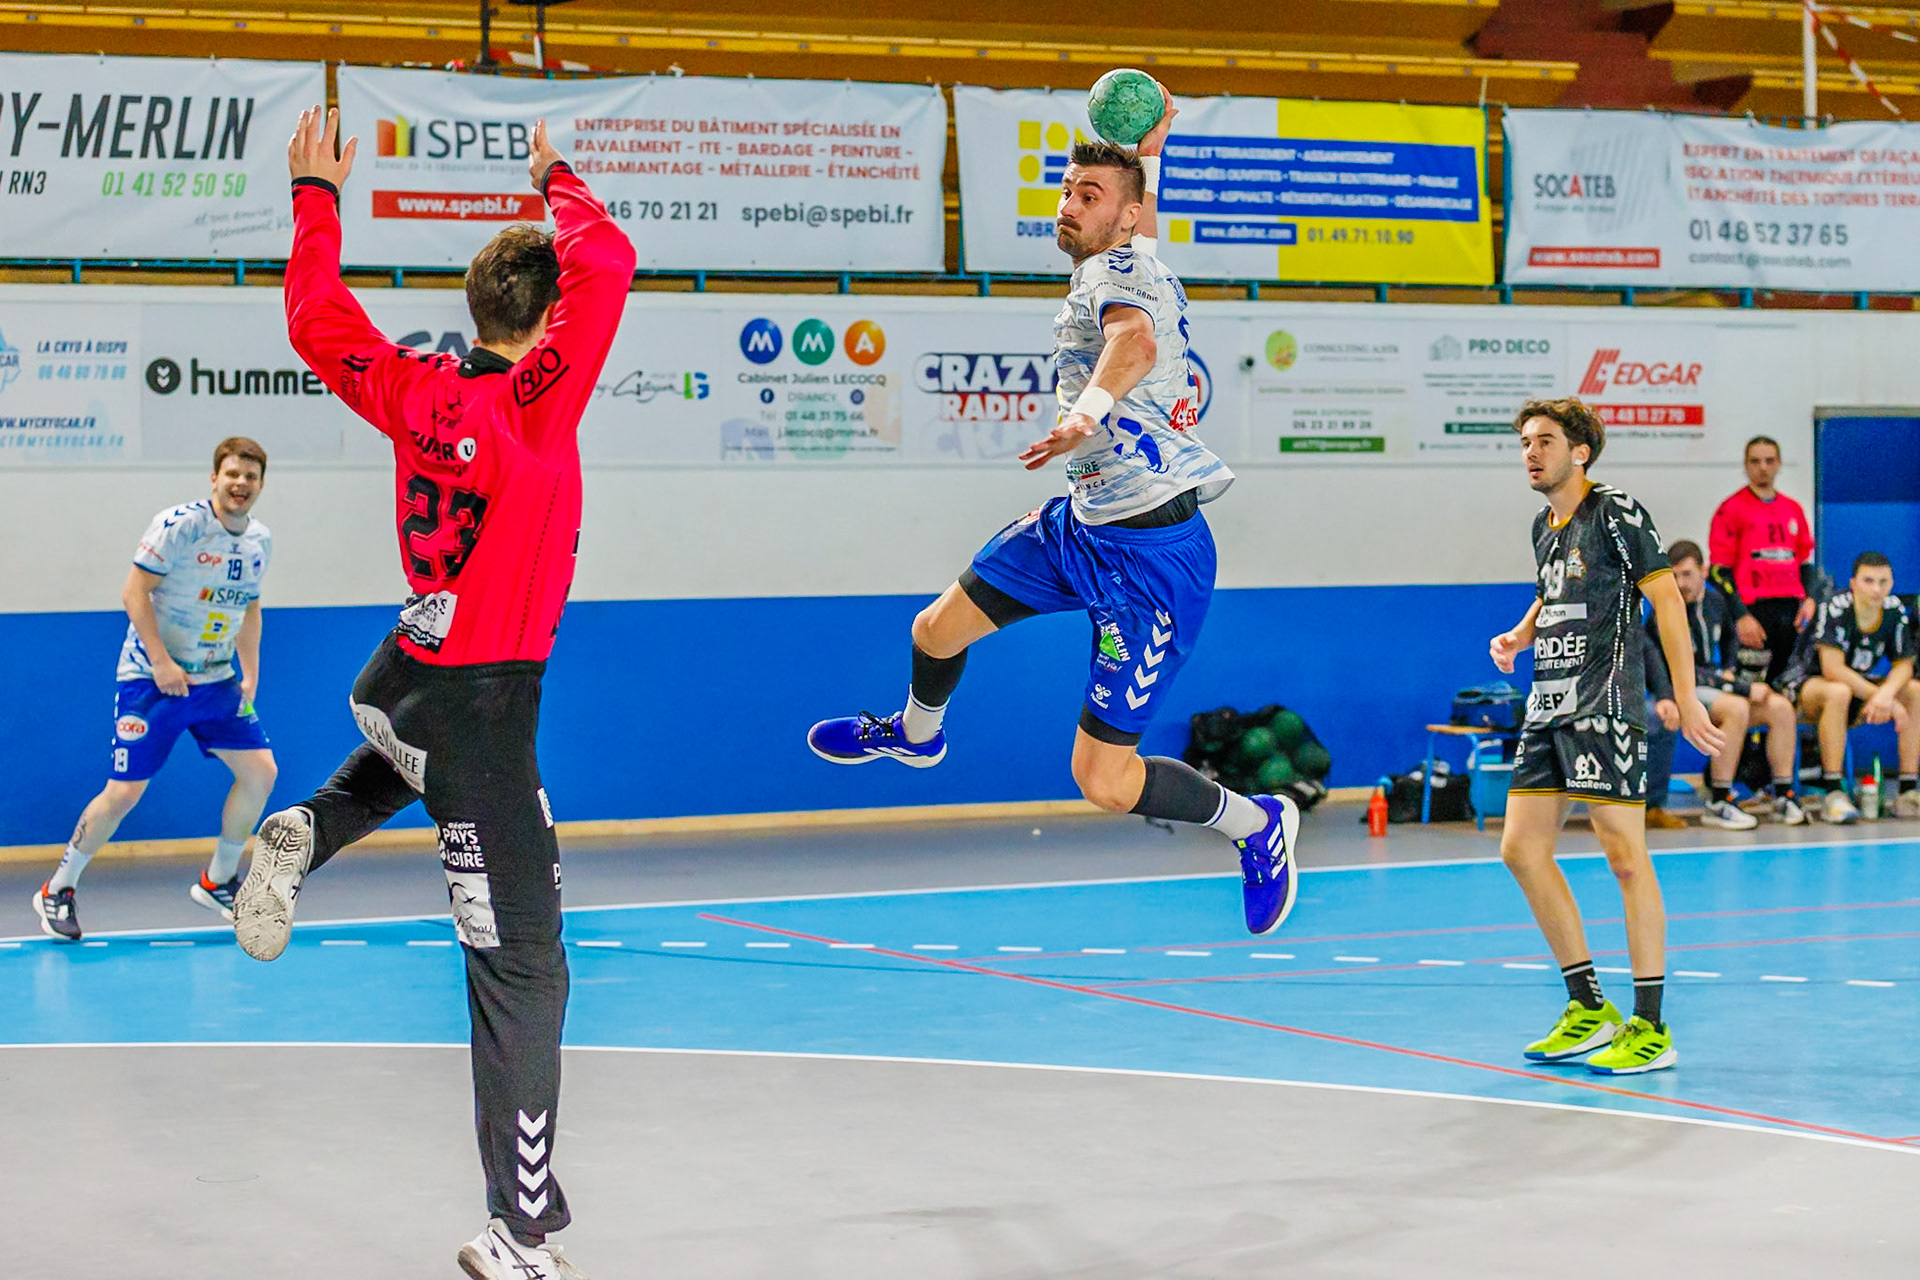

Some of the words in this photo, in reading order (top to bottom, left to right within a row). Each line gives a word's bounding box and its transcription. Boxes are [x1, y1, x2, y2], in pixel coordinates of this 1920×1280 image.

[0, 92, 254, 160] Y-MERLIN
[575, 119, 667, 132] ENTREPRISE
[672, 120, 695, 133] DU
[699, 118, 777, 136] BÂTIMENT
[783, 120, 876, 138] SPÉCIALISÉE
[881, 125, 900, 138] EN
[427, 119, 530, 160] SPEB
[575, 140, 682, 154] RAVALEMENT
[699, 141, 721, 155] ITE
[738, 143, 814, 157] BARDAGE
[831, 146, 901, 159] PEINTURE
[575, 159, 703, 176] DÉSAMIANTAGE
[720, 161, 812, 178] MÉTALLERIE
[8, 171, 47, 194] RN3
[102, 172, 124, 196] 01
[132, 172, 154, 196] 41
[161, 172, 183, 197] 52
[192, 173, 215, 197] 50
[222, 173, 247, 198] 50
[1534, 174, 1616, 198] SOCATEB
[398, 196, 522, 219] www.spebi.fr
[639, 202, 663, 220] 70
[671, 202, 692, 221] 21
[698, 202, 718, 221] 21
[742, 203, 914, 229] spebi@spebi.fr
[1016, 221, 1057, 237] DUBR
[1689, 219, 1712, 240] 01
[1718, 220, 1749, 243] 48
[1755, 221, 1780, 245] 52
[1787, 223, 1813, 246] 37
[1819, 224, 1849, 246] 65
[37, 341, 50, 353] LA
[1468, 338, 1501, 353] PRO
[1506, 339, 1551, 354] DECO
[191, 358, 332, 395] humme
[738, 373, 788, 385] Cabinet
[792, 373, 830, 385] Julien
[834, 374, 887, 387] LECOCQ
[916, 353, 1056, 393] CRAZY
[1612, 362, 1703, 386] EDGAR
[941, 393, 1043, 421] RADIO
[402, 473, 490, 583] 23
[227, 559, 243, 581] 19
[443, 827, 478, 845] PAYS
[446, 849, 485, 868] LOIRE
